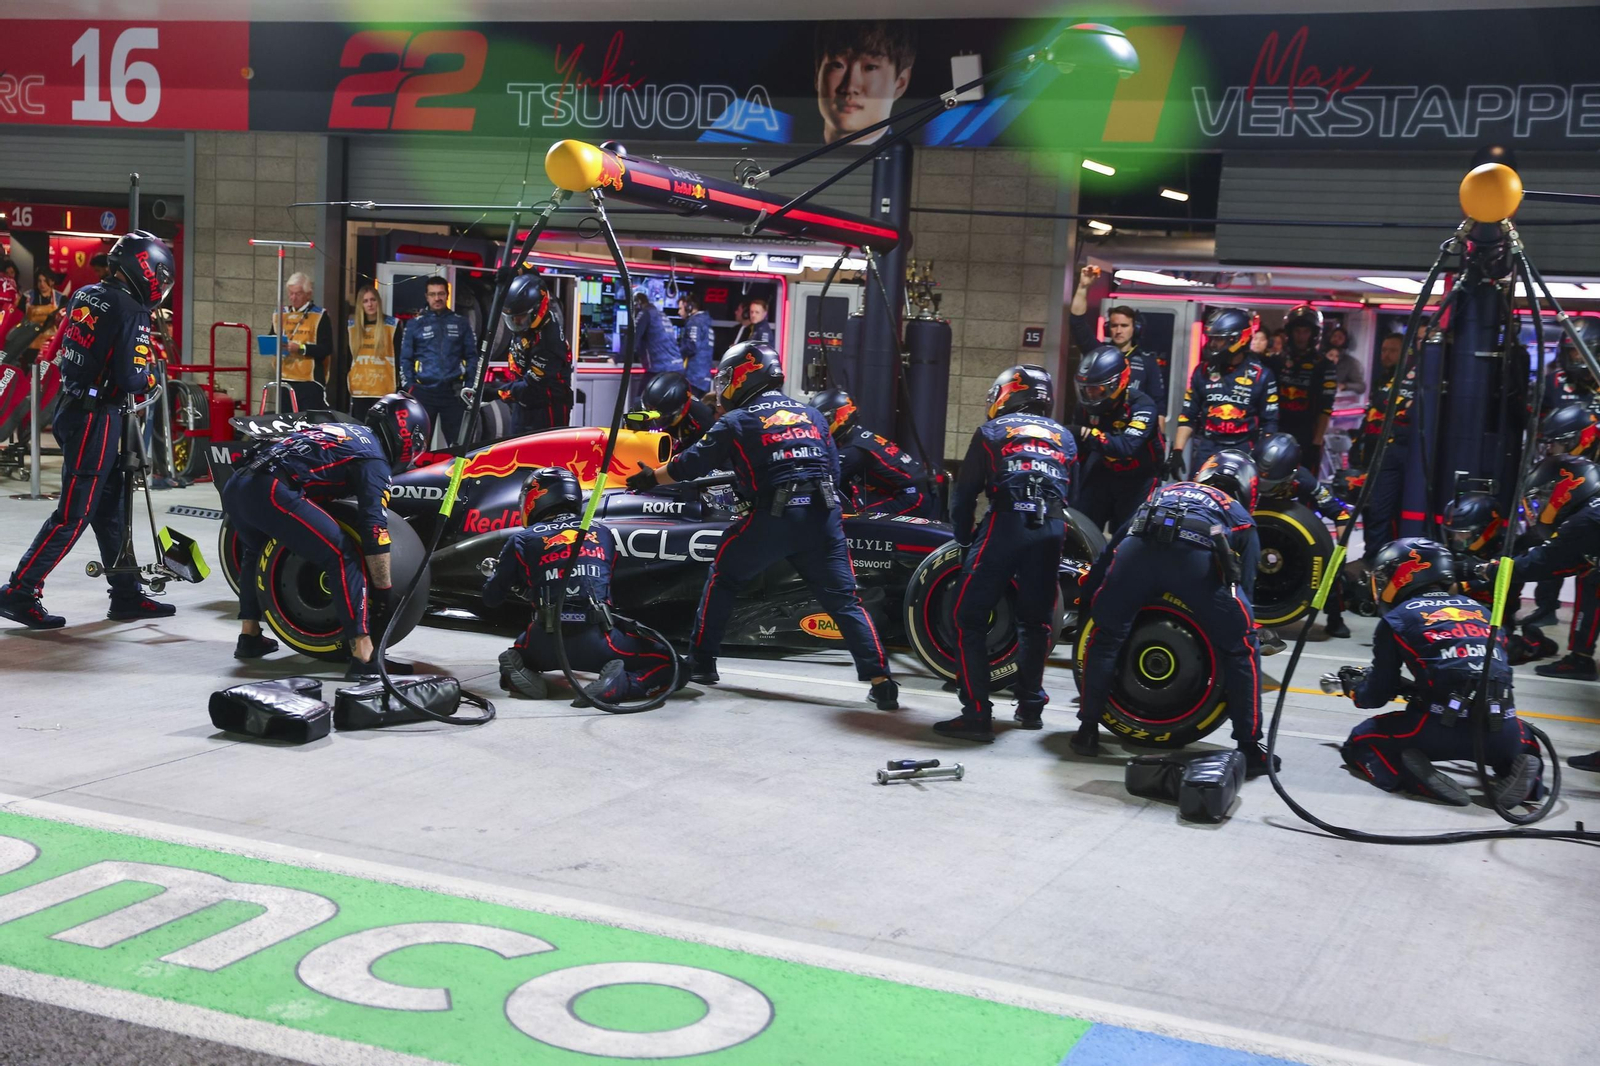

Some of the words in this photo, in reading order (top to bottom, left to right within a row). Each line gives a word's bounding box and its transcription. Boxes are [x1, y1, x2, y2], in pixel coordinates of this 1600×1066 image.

[71, 27, 161, 122] 16
[554, 30, 647, 120] Yuki
[1246, 26, 1372, 111] Max
[328, 30, 488, 131] 22
[506, 83, 779, 130] TSUNODA
[1191, 84, 1600, 138] VERSTAPPE
[668, 166, 704, 183] ORACLE
[11, 206, 32, 227] 16
[102, 212, 115, 231] hp
[135, 250, 156, 280] Red
[769, 256, 798, 264] ORACLE
[75, 290, 111, 313] ORACLE
[1025, 332, 1040, 342] 15
[748, 400, 807, 413] ORACLE
[1206, 393, 1251, 405] ORACLE
[395, 408, 411, 437] Red
[995, 417, 1065, 432] ORACLE
[761, 427, 794, 446] Red
[794, 425, 822, 440] Bull
[772, 447, 808, 462] Mobil
[1001, 439, 1037, 456] Red
[1037, 441, 1067, 464] Bull
[1007, 460, 1049, 473] Mobil
[642, 501, 686, 514] ROKT
[463, 509, 509, 534] Red
[259, 537, 278, 572] ZE
[920, 568, 929, 586] P
[932, 548, 962, 570] ZE
[257, 576, 266, 591] P
[1405, 599, 1482, 610] ORACLE
[1422, 623, 1465, 644] Red
[1154, 732, 1171, 742] P
